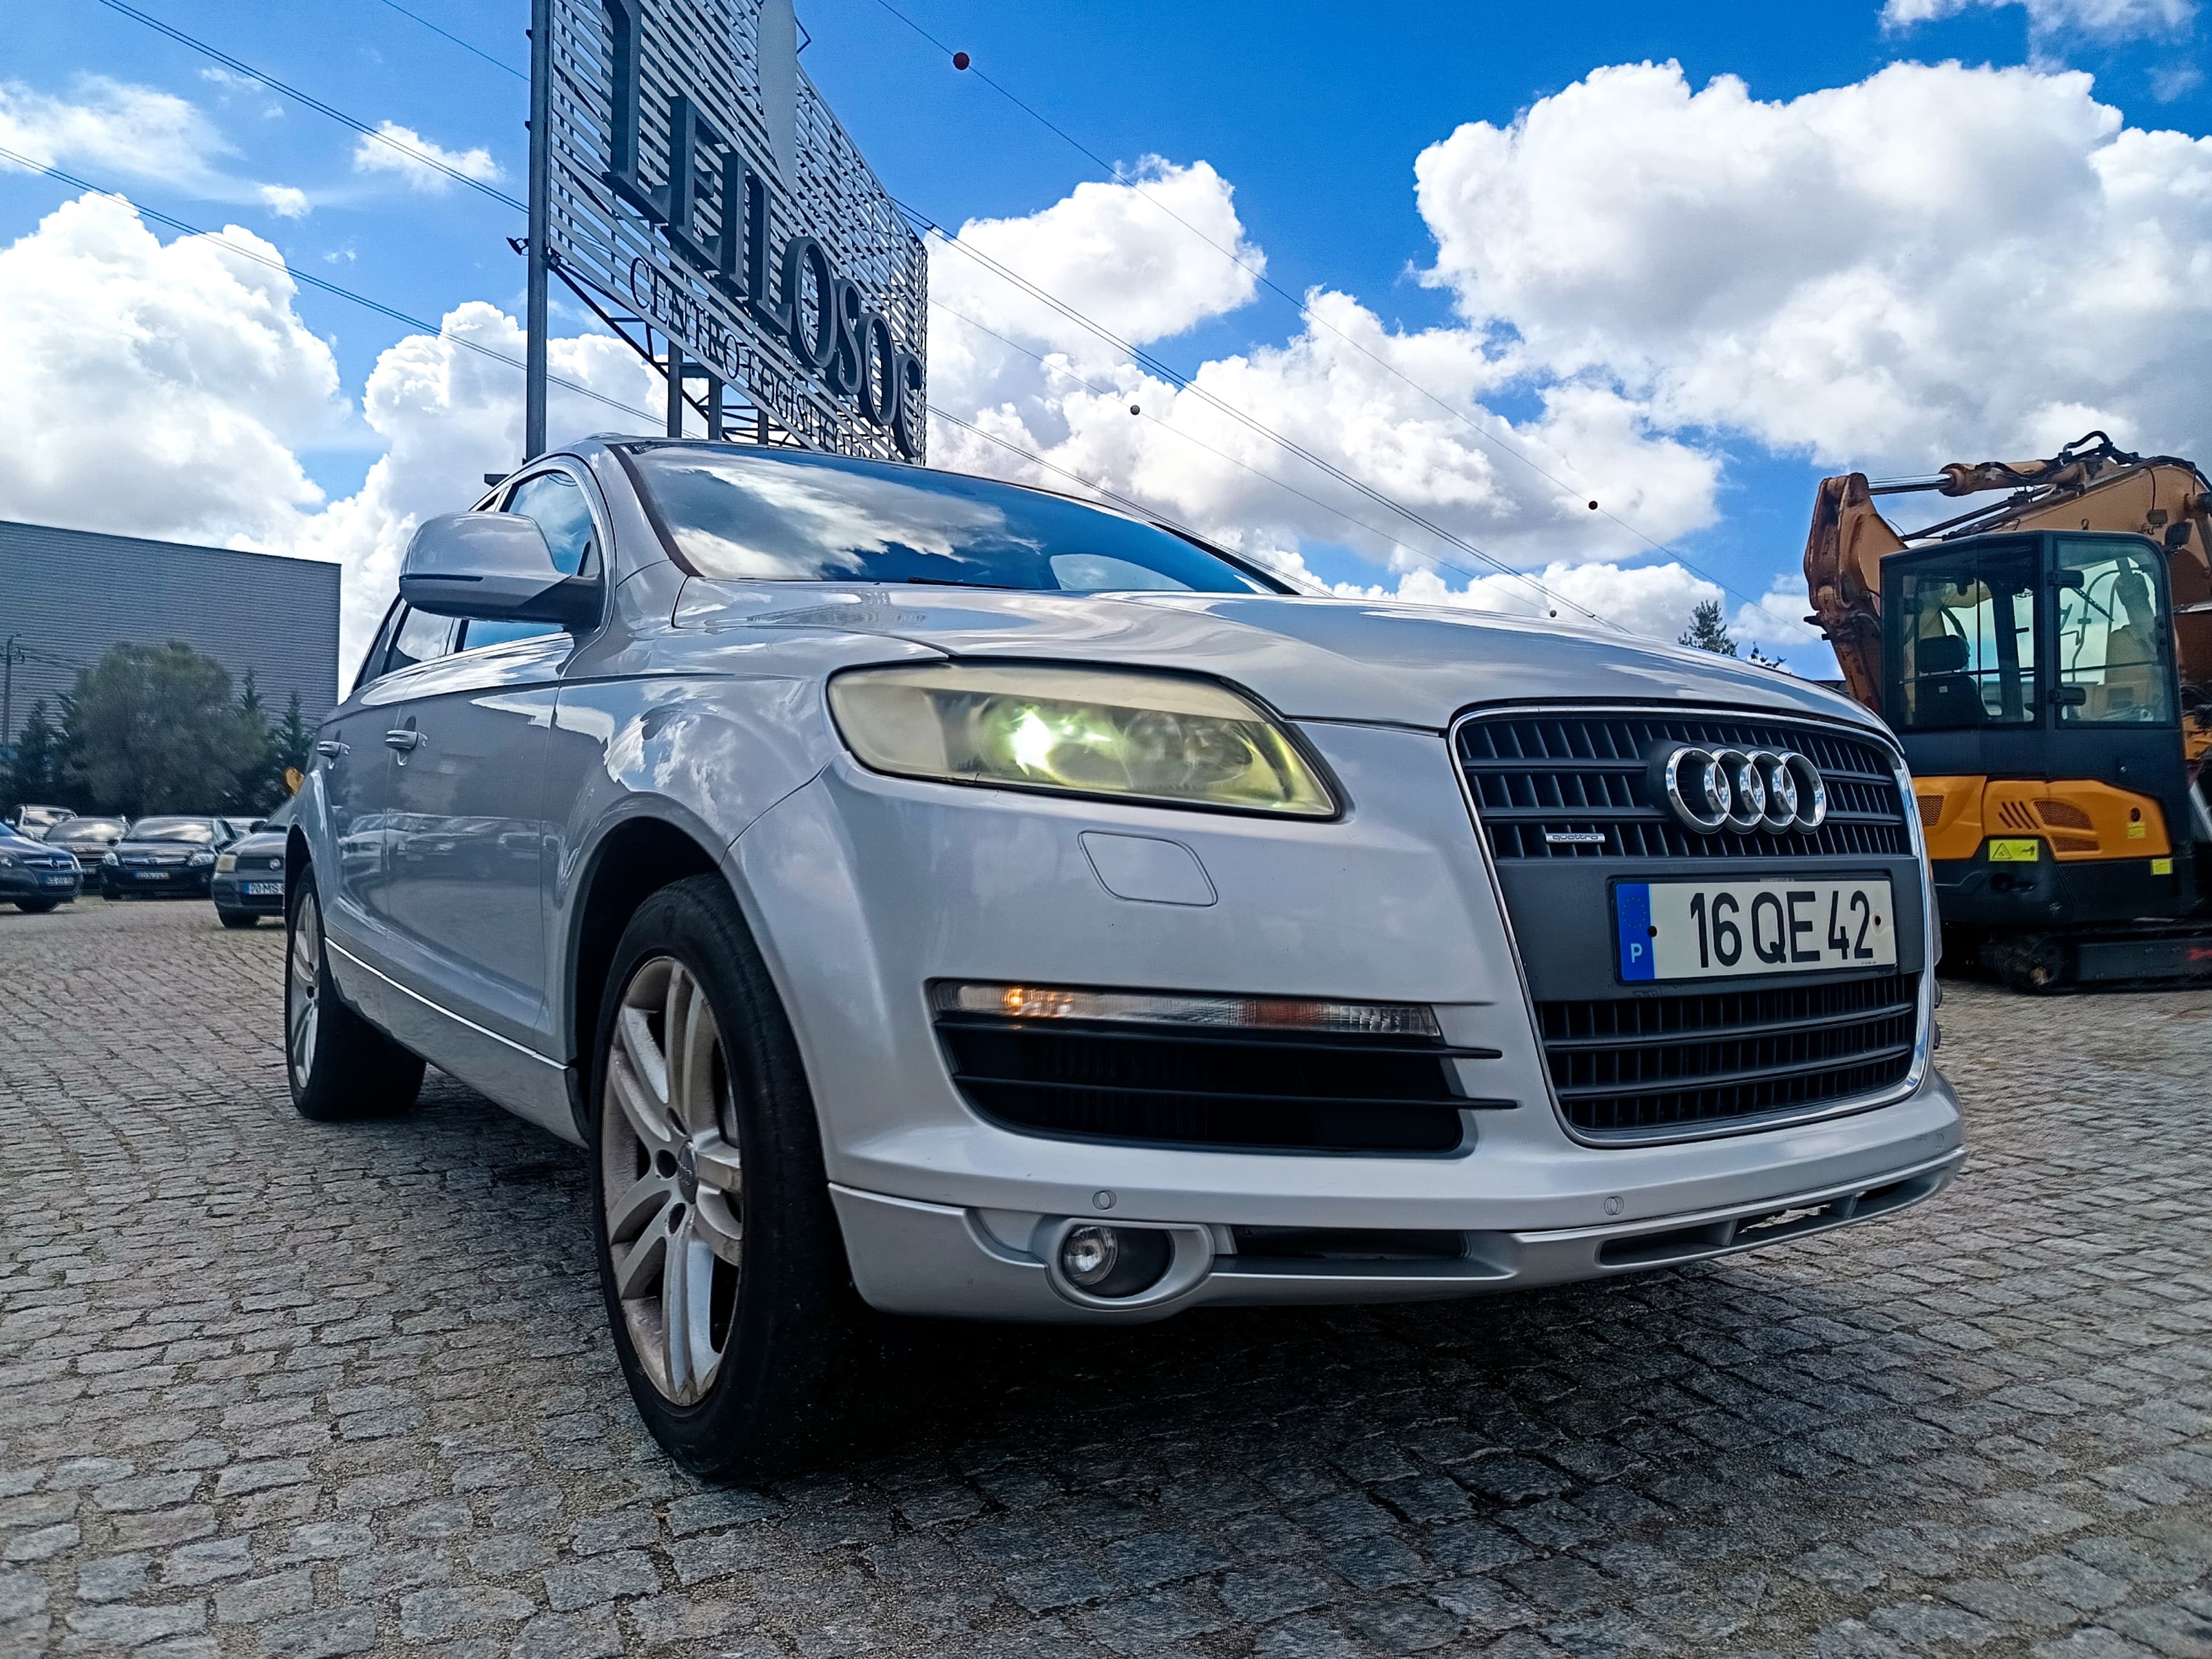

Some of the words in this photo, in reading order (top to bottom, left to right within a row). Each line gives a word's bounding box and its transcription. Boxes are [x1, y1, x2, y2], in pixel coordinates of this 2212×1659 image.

[602, 0, 922, 459] LEILOSOC
[630, 257, 740, 380] CENTRO
[1630, 943, 1643, 964] P
